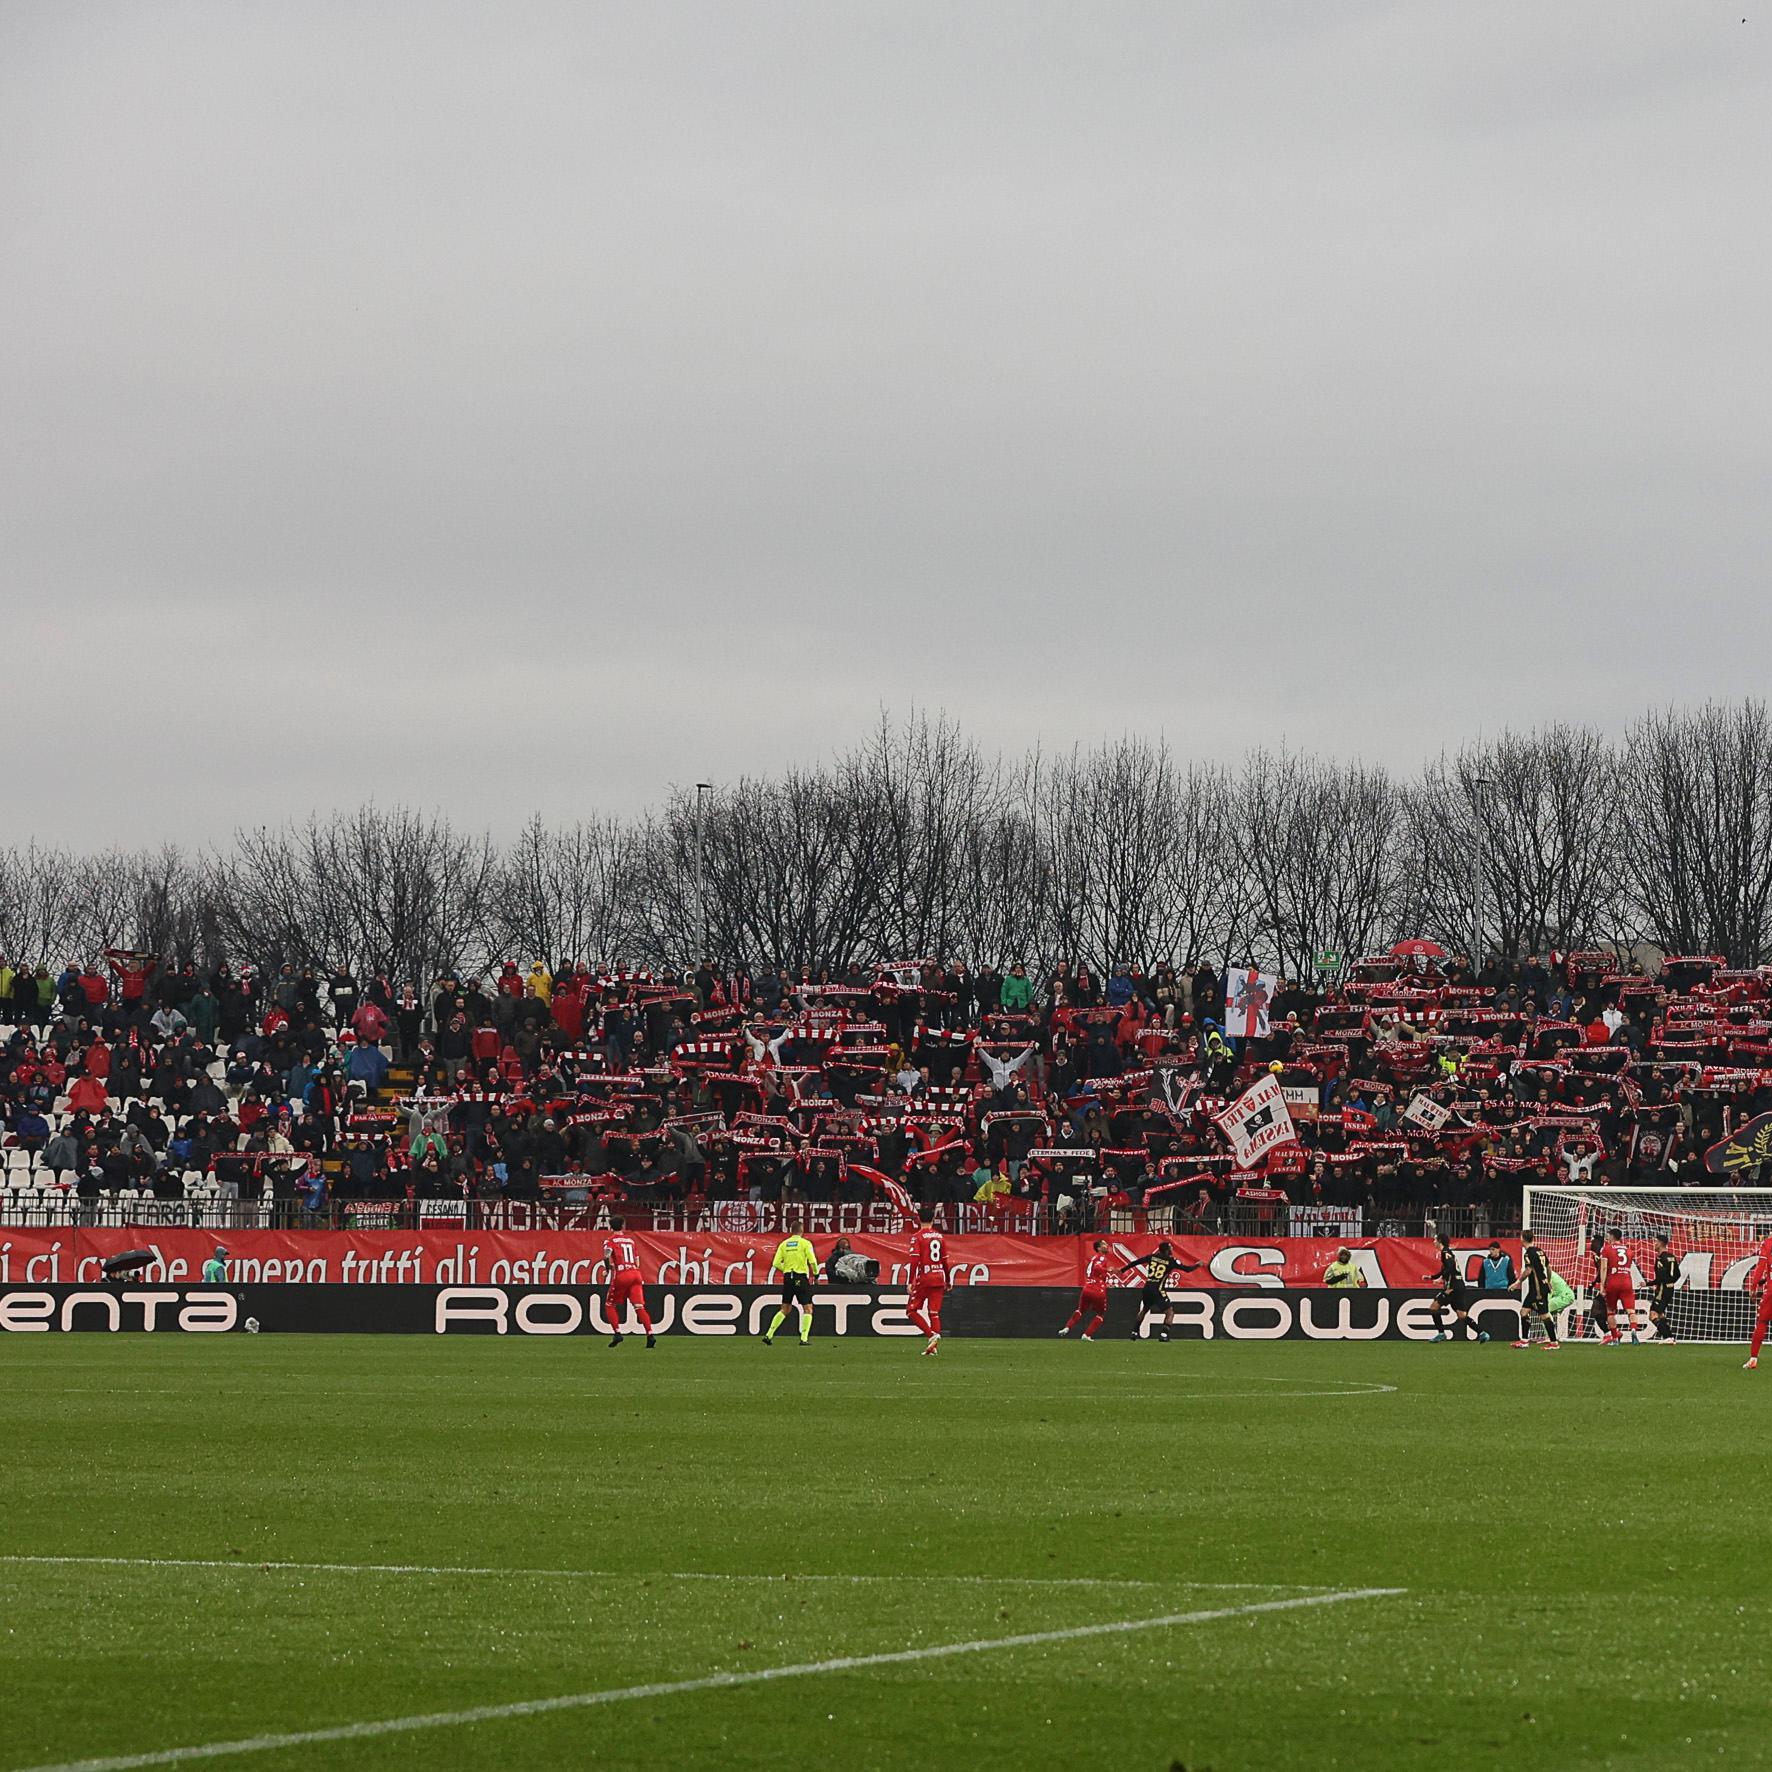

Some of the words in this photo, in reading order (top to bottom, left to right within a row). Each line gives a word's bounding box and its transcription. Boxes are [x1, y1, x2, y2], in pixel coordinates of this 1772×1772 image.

[1392, 990, 1418, 998] MONZA
[704, 1007, 737, 1019] MONZA
[1481, 1012, 1516, 1020] MONZA
[1335, 1029, 1363, 1037] MONZA
[1364, 1082, 1390, 1092] MONZA
[801, 1099, 833, 1107] MONZA
[577, 1112, 610, 1122] MONZA
[751, 1116, 778, 1124] MONZA
[734, 1136, 765, 1145] MONZA
[1330, 1152, 1365, 1162] MONZA
[564, 1178, 592, 1186] MONZA
[479, 1200, 613, 1232] MONZA
[621, 1243, 635, 1263] 11
[928, 1239, 942, 1263] 8
[1616, 1248, 1628, 1266] 3
[341, 1245, 424, 1284] tutti
[656, 1245, 714, 1286] chi
[725, 1247, 757, 1286] ci
[1148, 1261, 1166, 1279] 38
